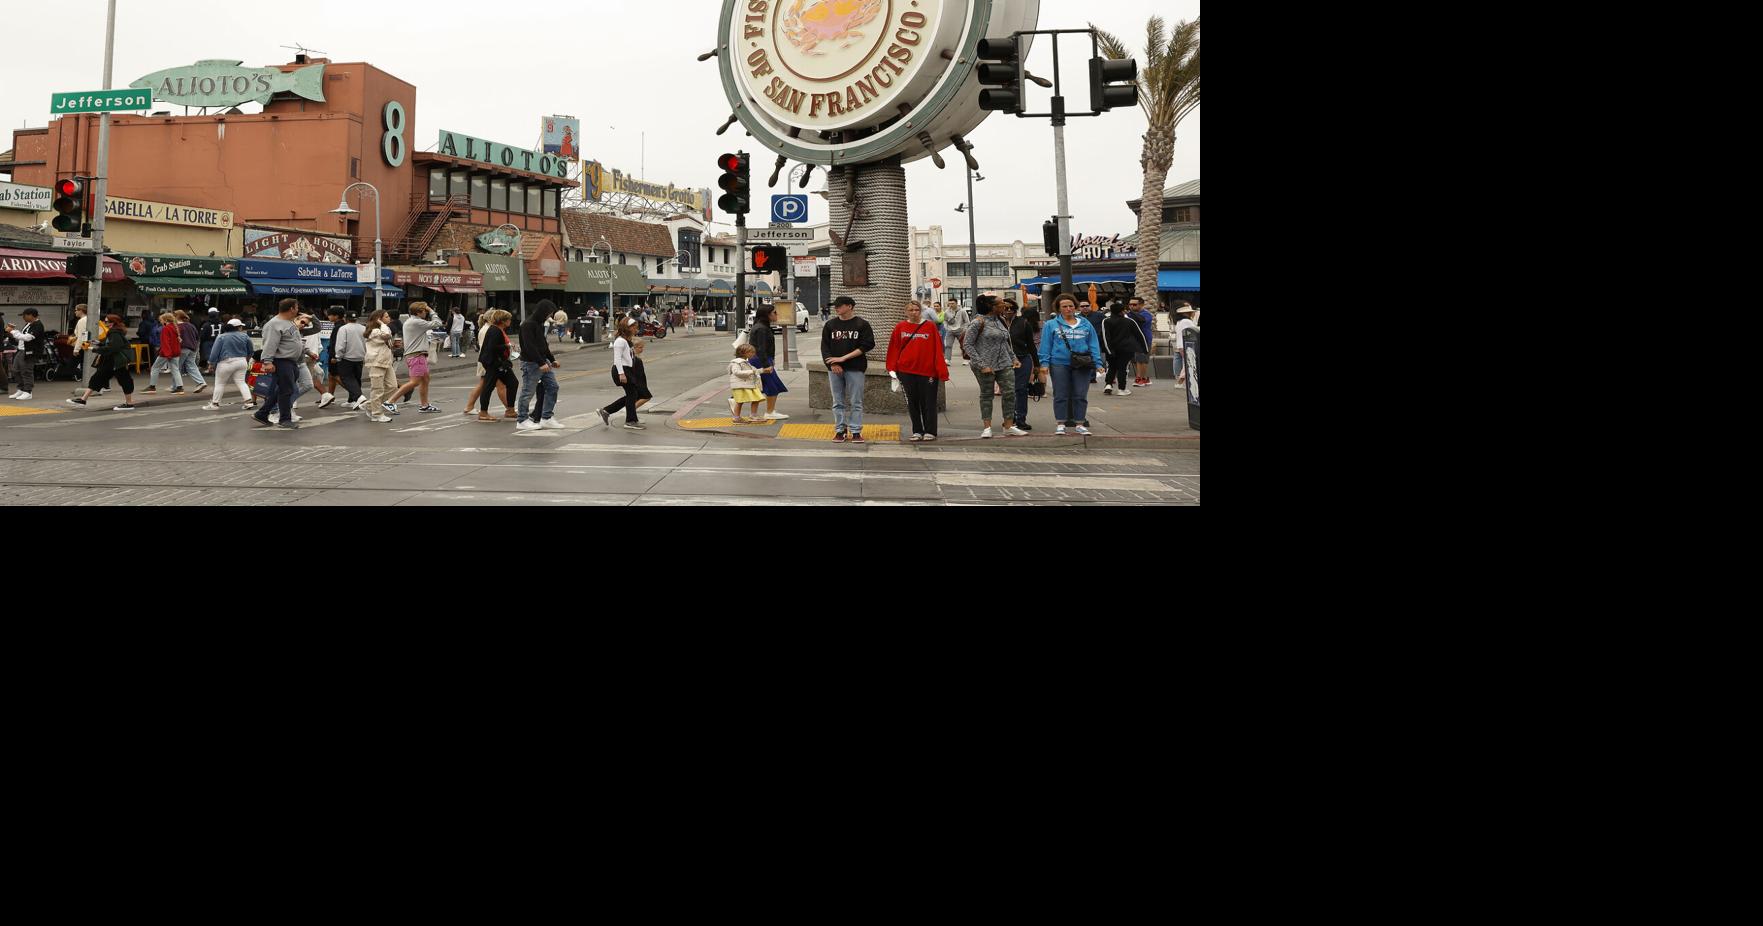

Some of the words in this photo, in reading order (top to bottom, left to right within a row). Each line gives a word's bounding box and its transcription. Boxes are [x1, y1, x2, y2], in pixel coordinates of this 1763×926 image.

[747, 48, 774, 78] OF
[763, 76, 807, 114] SAN
[808, 11, 927, 117] FRANCISCO
[158, 73, 273, 97] ALIOTO'S
[56, 94, 146, 109] Jefferson
[381, 100, 406, 168] 8
[441, 133, 568, 178] ALIOTO'S
[590, 162, 602, 199] 9
[13, 188, 50, 201] Station
[668, 181, 695, 204] Grotto
[165, 207, 179, 221] LA
[183, 208, 218, 225] TORRE
[782, 200, 798, 217] P
[753, 230, 808, 238] Jefferson
[63, 239, 86, 247] Taylor
[245, 234, 289, 254] LIGHT
[314, 237, 351, 261] HOUSE
[1070, 233, 1138, 253] howder
[1082, 245, 1111, 259] HUT
[152, 263, 167, 273] Crab
[168, 259, 191, 270] Station
[297, 266, 322, 277] Sabella
[330, 268, 353, 279] LaTorre
[484, 263, 510, 274] ALIOTO'S
[587, 269, 618, 279] ALIOTS
[210, 324, 222, 337] H
[831, 330, 859, 339] TOKYO
